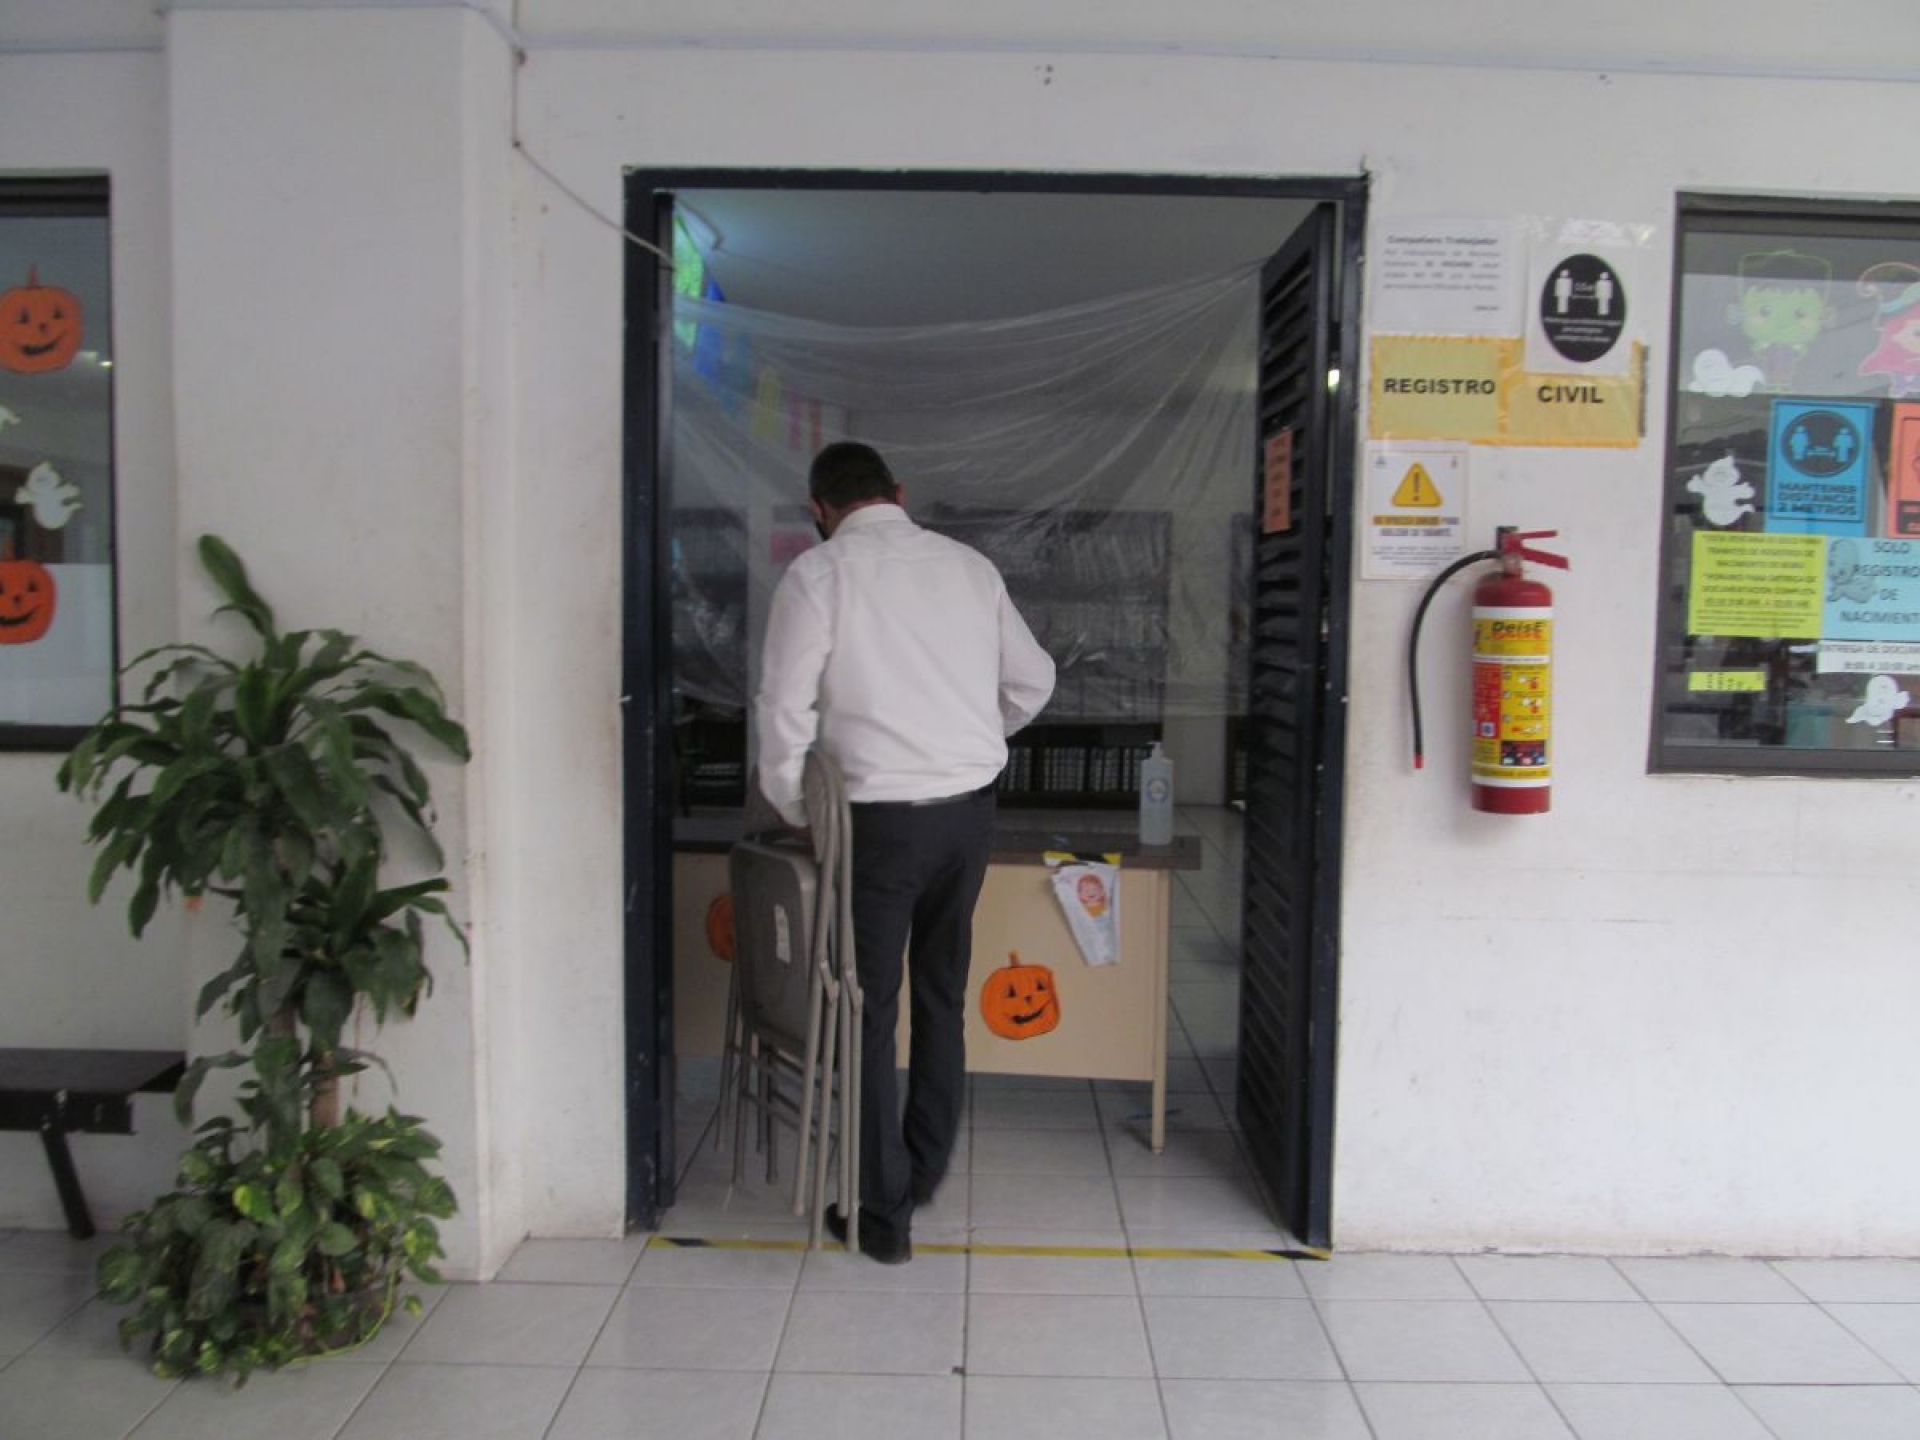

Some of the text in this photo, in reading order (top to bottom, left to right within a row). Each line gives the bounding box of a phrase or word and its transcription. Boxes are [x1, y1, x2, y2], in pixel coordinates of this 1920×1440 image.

[1383, 377, 1604, 404] REGISTRO CIVIL
[1873, 540, 1910, 554] SOLO
[1852, 564, 1920, 578] REGISTRO
[1879, 588, 1899, 601] DE
